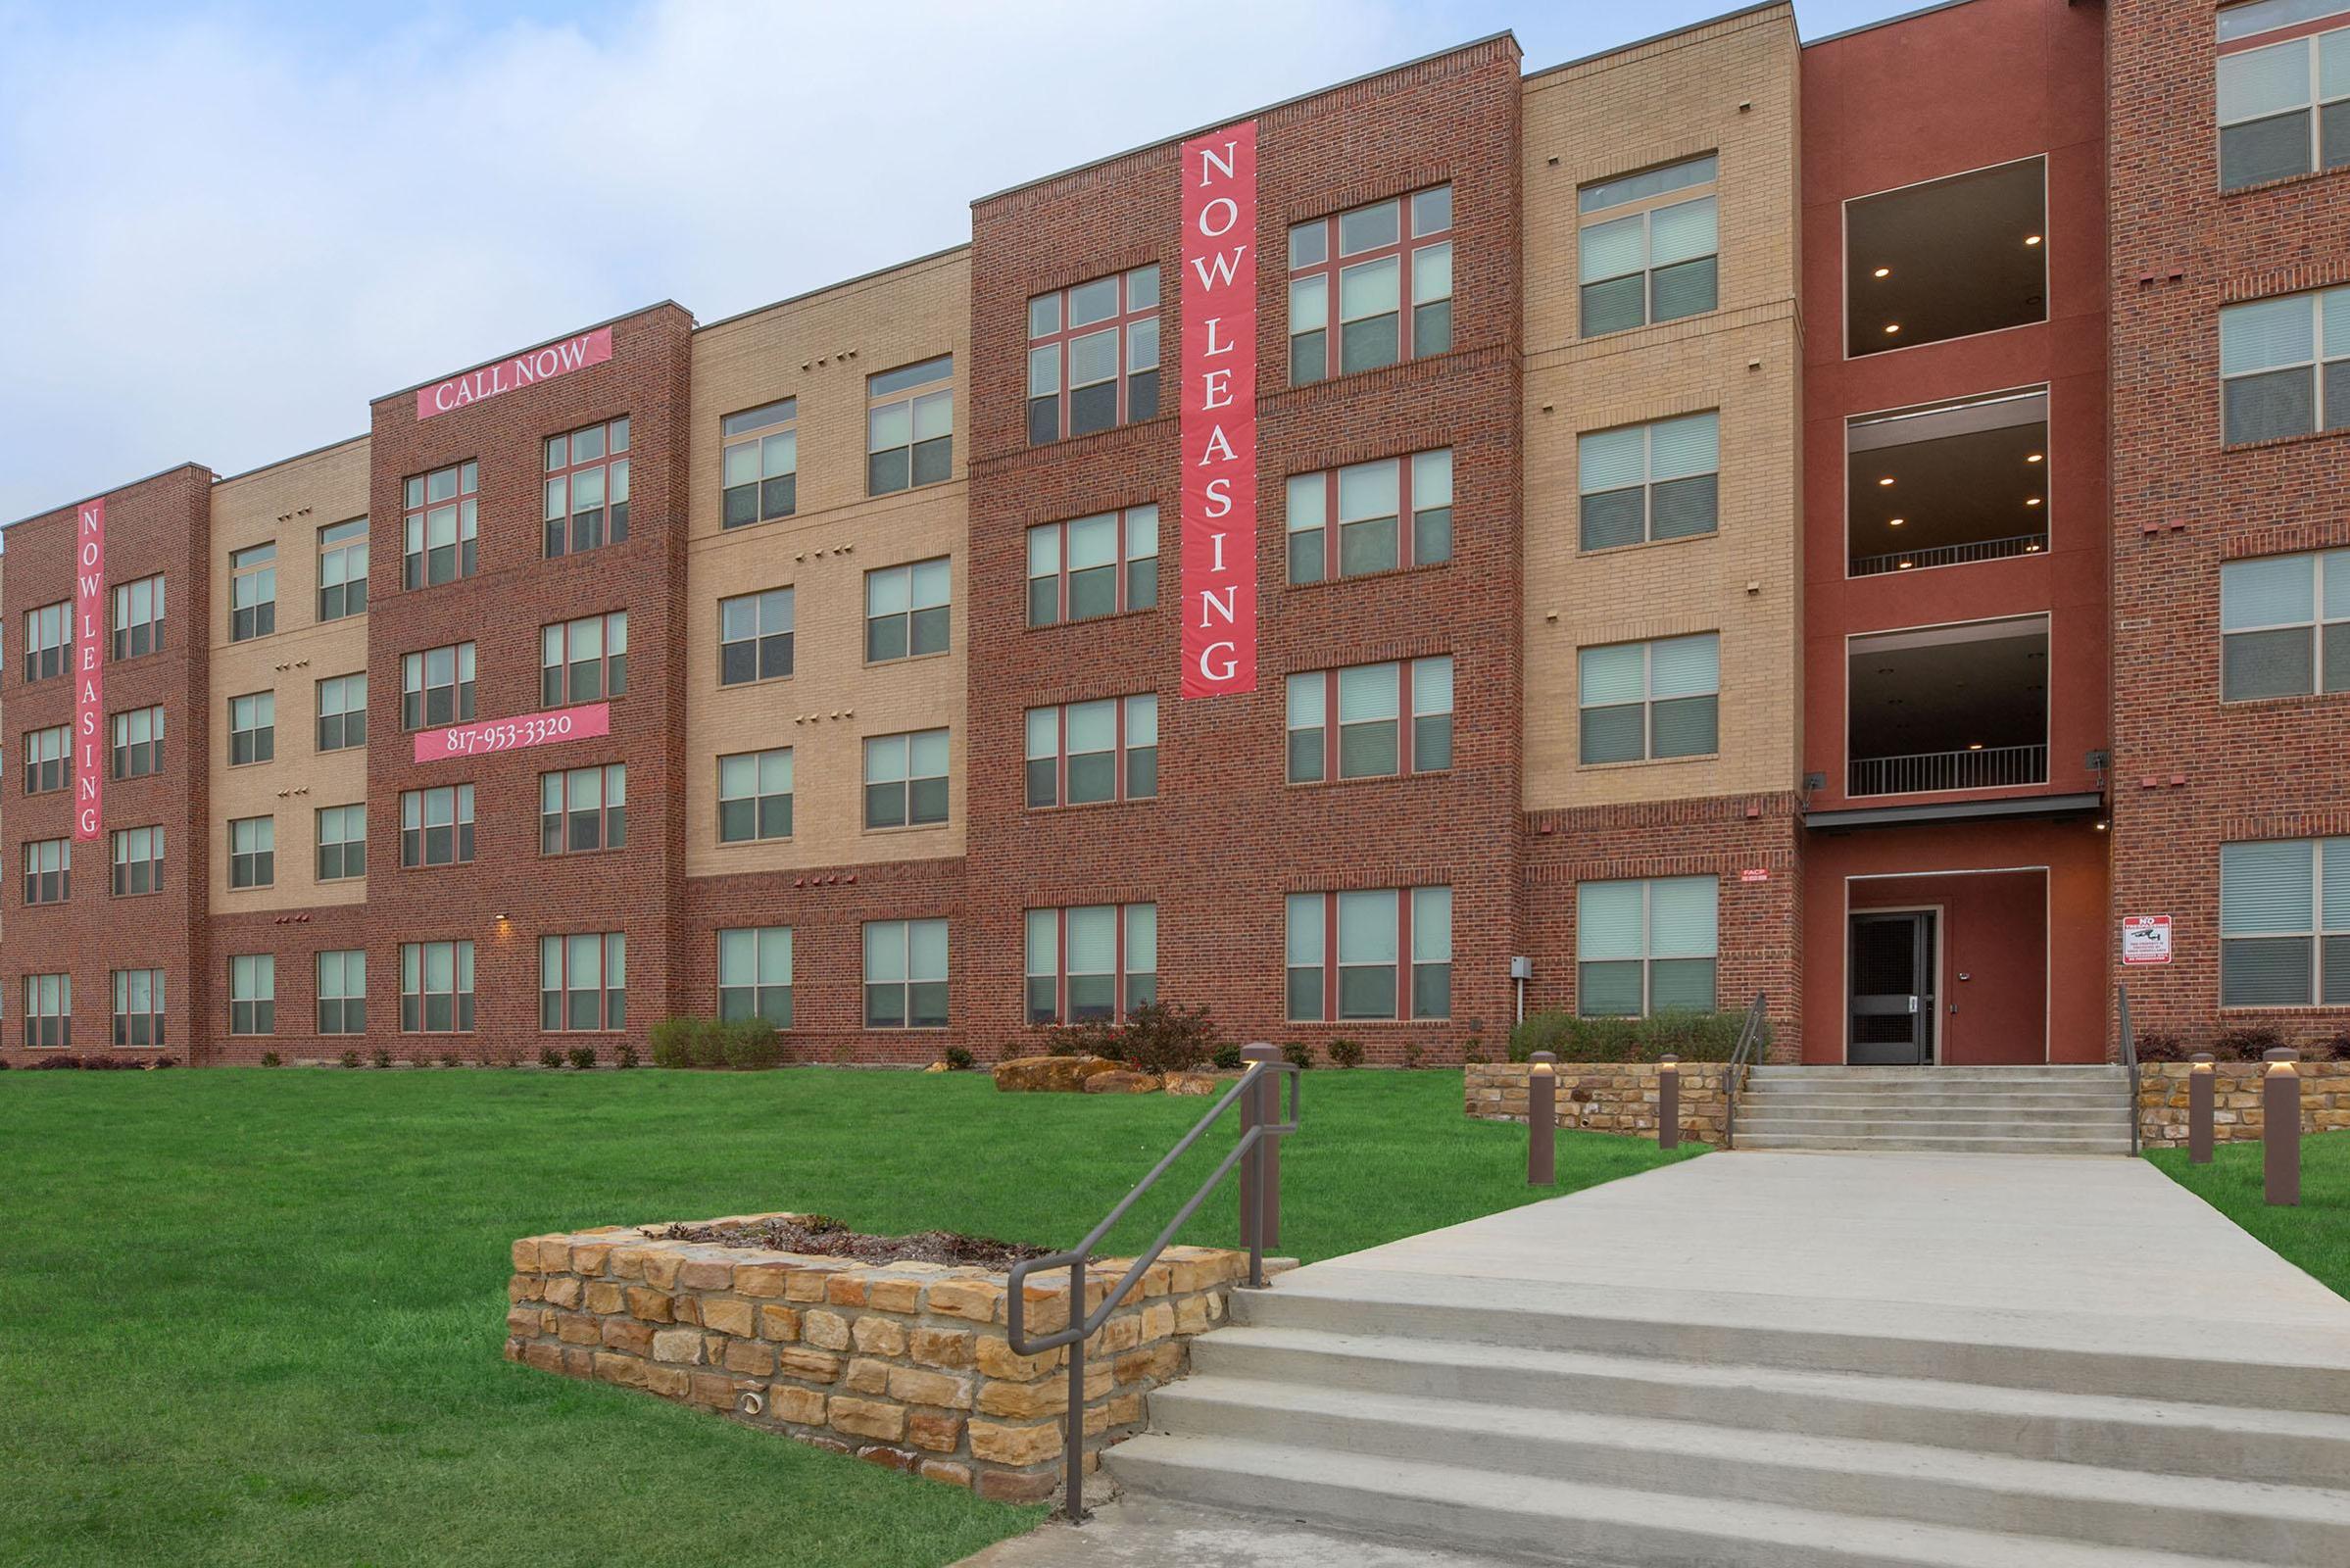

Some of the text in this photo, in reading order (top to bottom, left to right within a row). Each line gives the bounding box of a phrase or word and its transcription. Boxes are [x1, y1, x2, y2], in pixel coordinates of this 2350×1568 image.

[435, 336, 589, 411] CALL NOW
[1192, 141, 1247, 681] NOW LEASING
[80, 510, 101, 832] NOW LEASING
[447, 715, 571, 753] 817-953-3320
